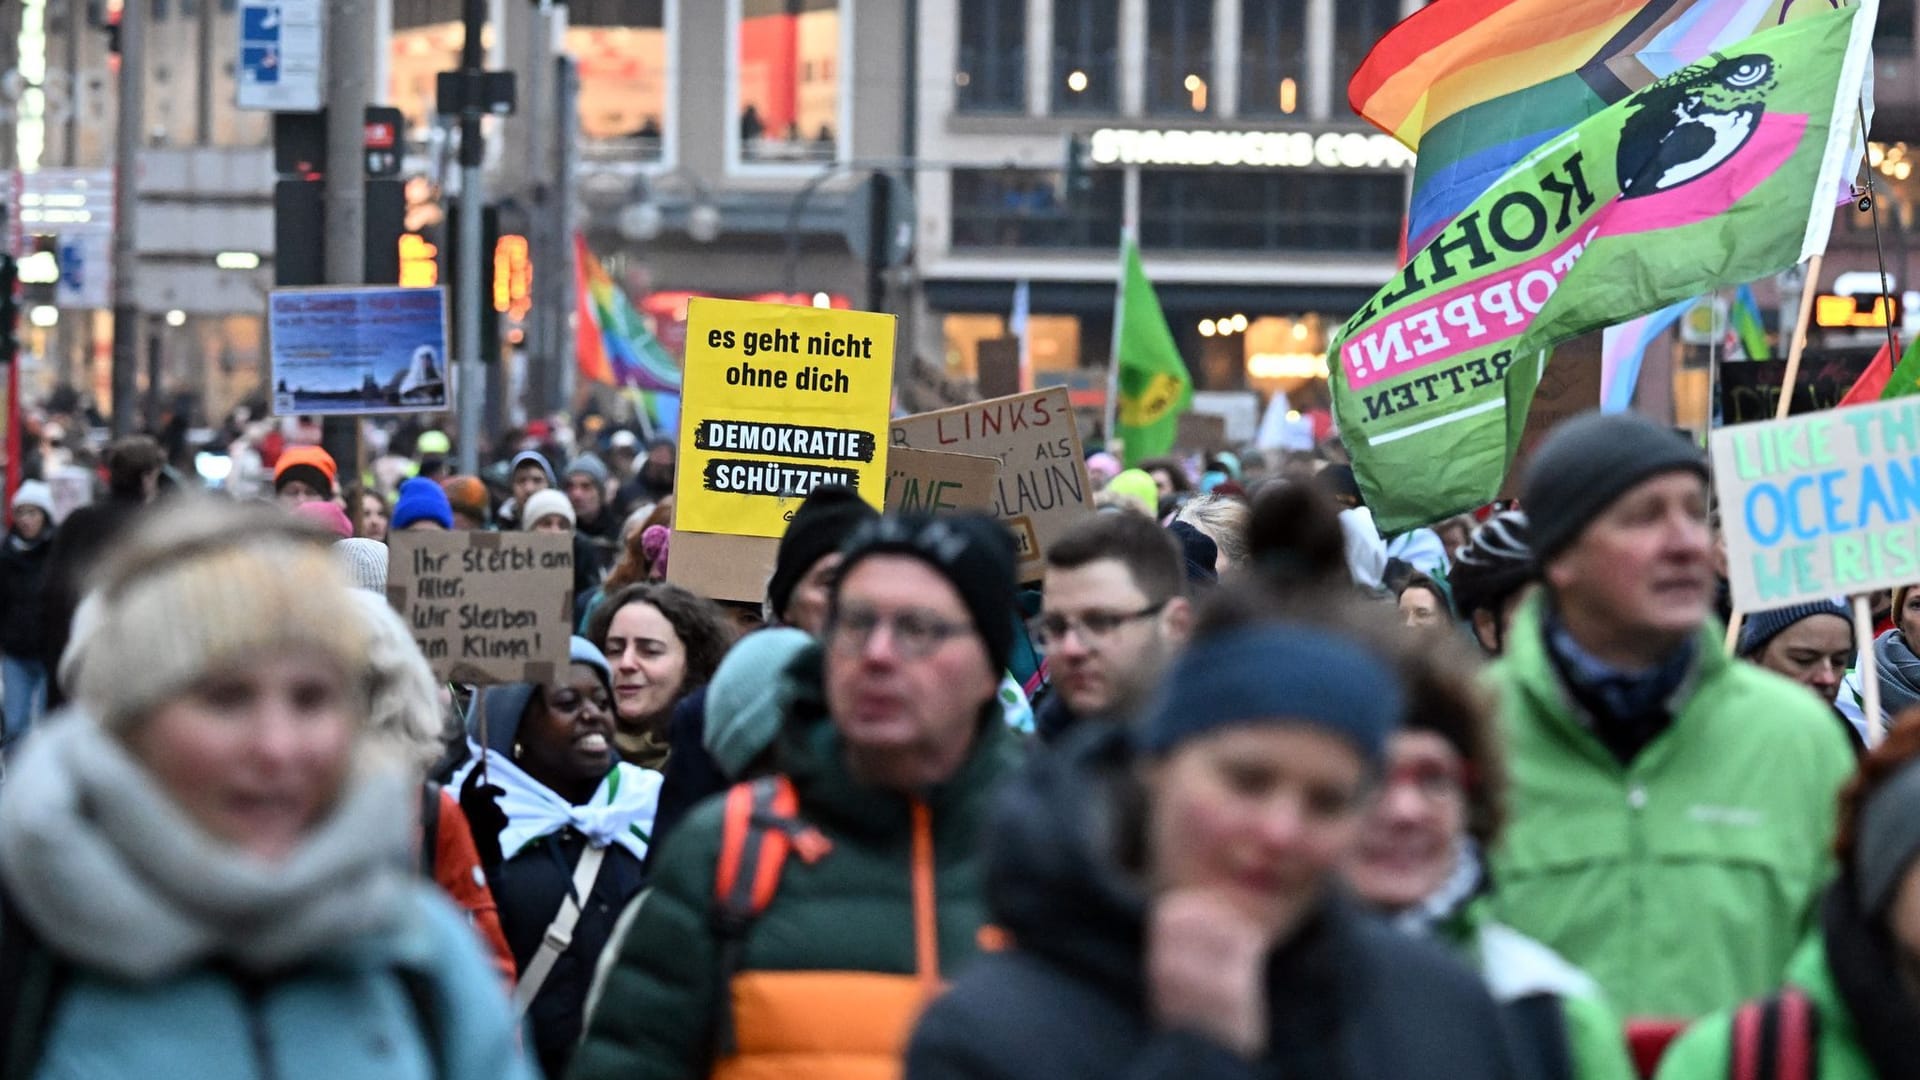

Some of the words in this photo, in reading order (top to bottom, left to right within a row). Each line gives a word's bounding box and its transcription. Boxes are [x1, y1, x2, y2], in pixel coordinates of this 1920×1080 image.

[708, 328, 736, 349] es
[743, 328, 800, 356] geht
[807, 331, 872, 359] nicht
[726, 362, 788, 388] ohne
[796, 366, 849, 393] dich
[708, 423, 861, 457] DEMOKRATIE
[937, 397, 1067, 445] LINKS-
[1732, 418, 1837, 481] LIKE
[1843, 400, 1920, 456] TH
[1036, 438, 1072, 461] ALS
[994, 461, 1083, 517] LAUN
[1744, 454, 1920, 547] OCEAN
[413, 547, 449, 575] Ihr
[540, 550, 572, 569] am
[1753, 545, 1822, 601] WE
[1831, 524, 1920, 585] RIS
